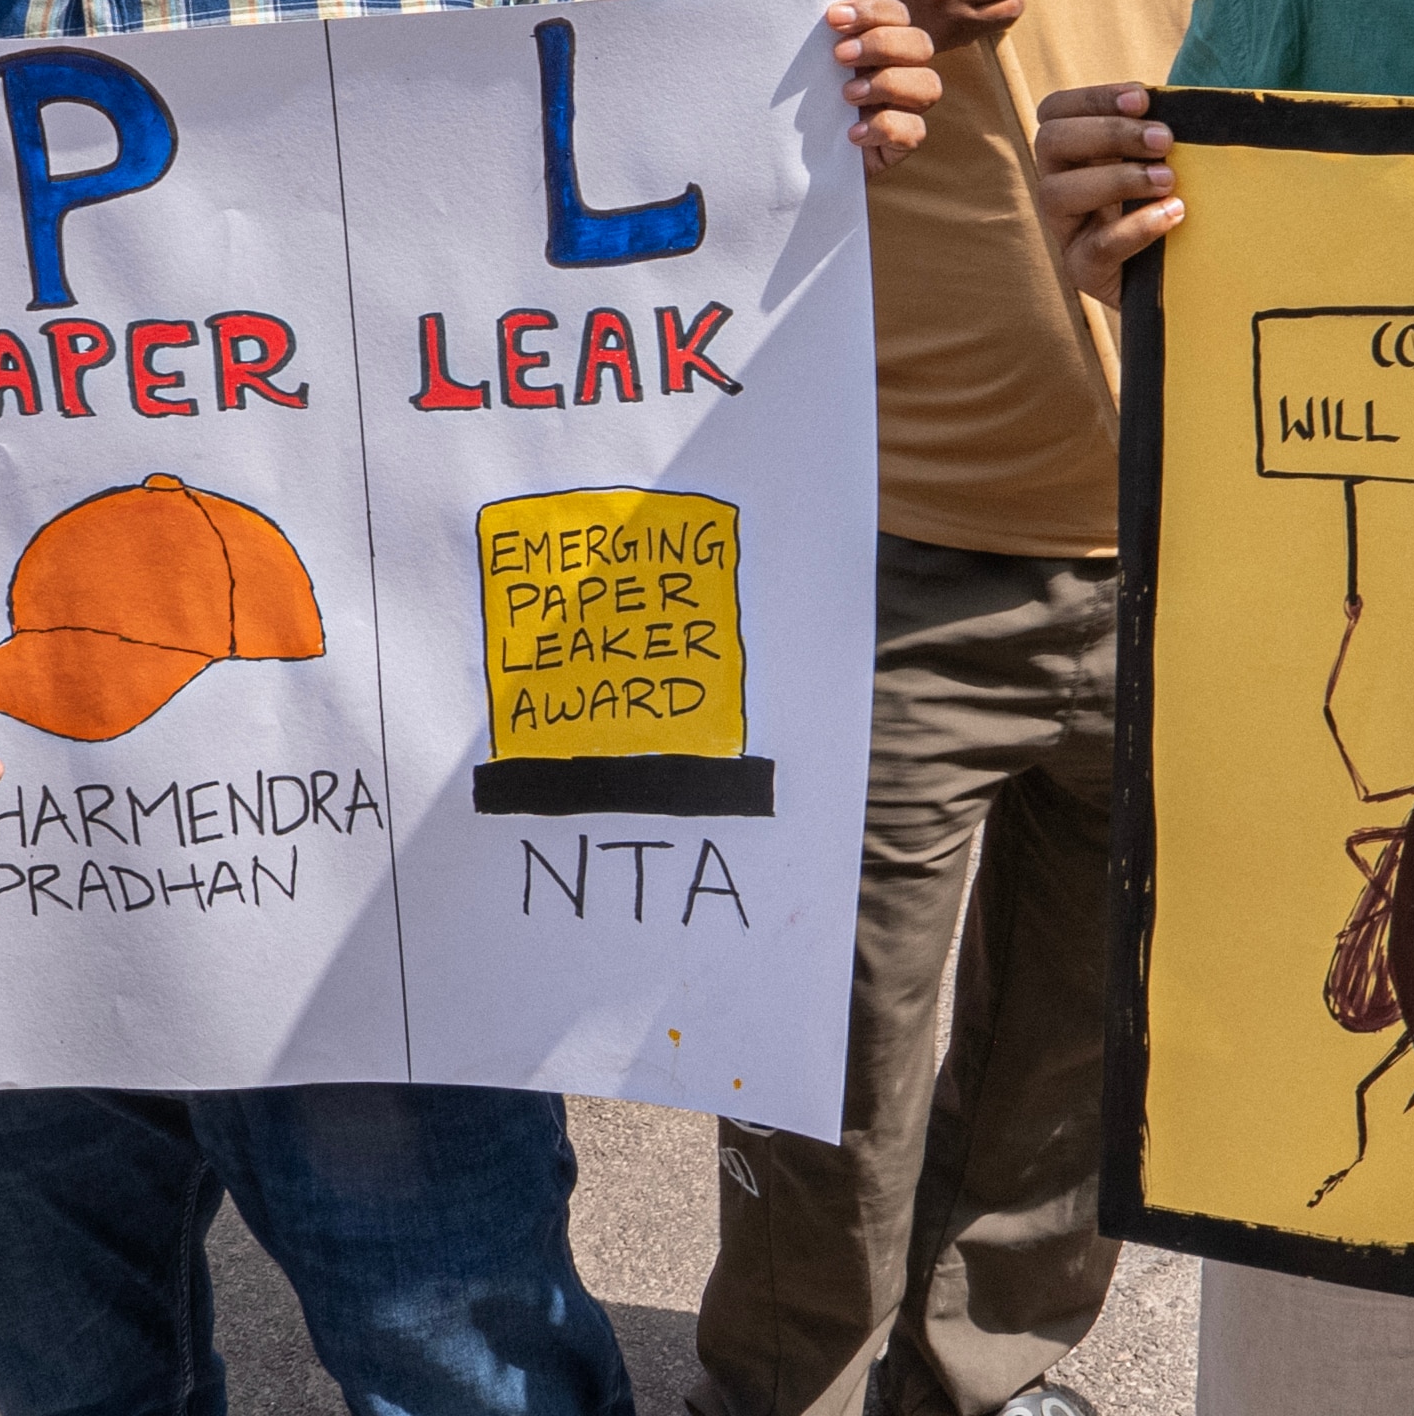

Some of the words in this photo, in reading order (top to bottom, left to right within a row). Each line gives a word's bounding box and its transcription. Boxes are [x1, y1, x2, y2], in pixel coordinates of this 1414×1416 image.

[533, 17, 707, 269] L
[409, 300, 744, 411] LEAK
[1280, 395, 1399, 443] WILL
[490, 520, 726, 576] EMERGING
[506, 572, 700, 628] PAPER
[501, 619, 721, 674] LEAKER
[511, 676, 706, 734] AWARD
[520, 833, 751, 930] NTA
